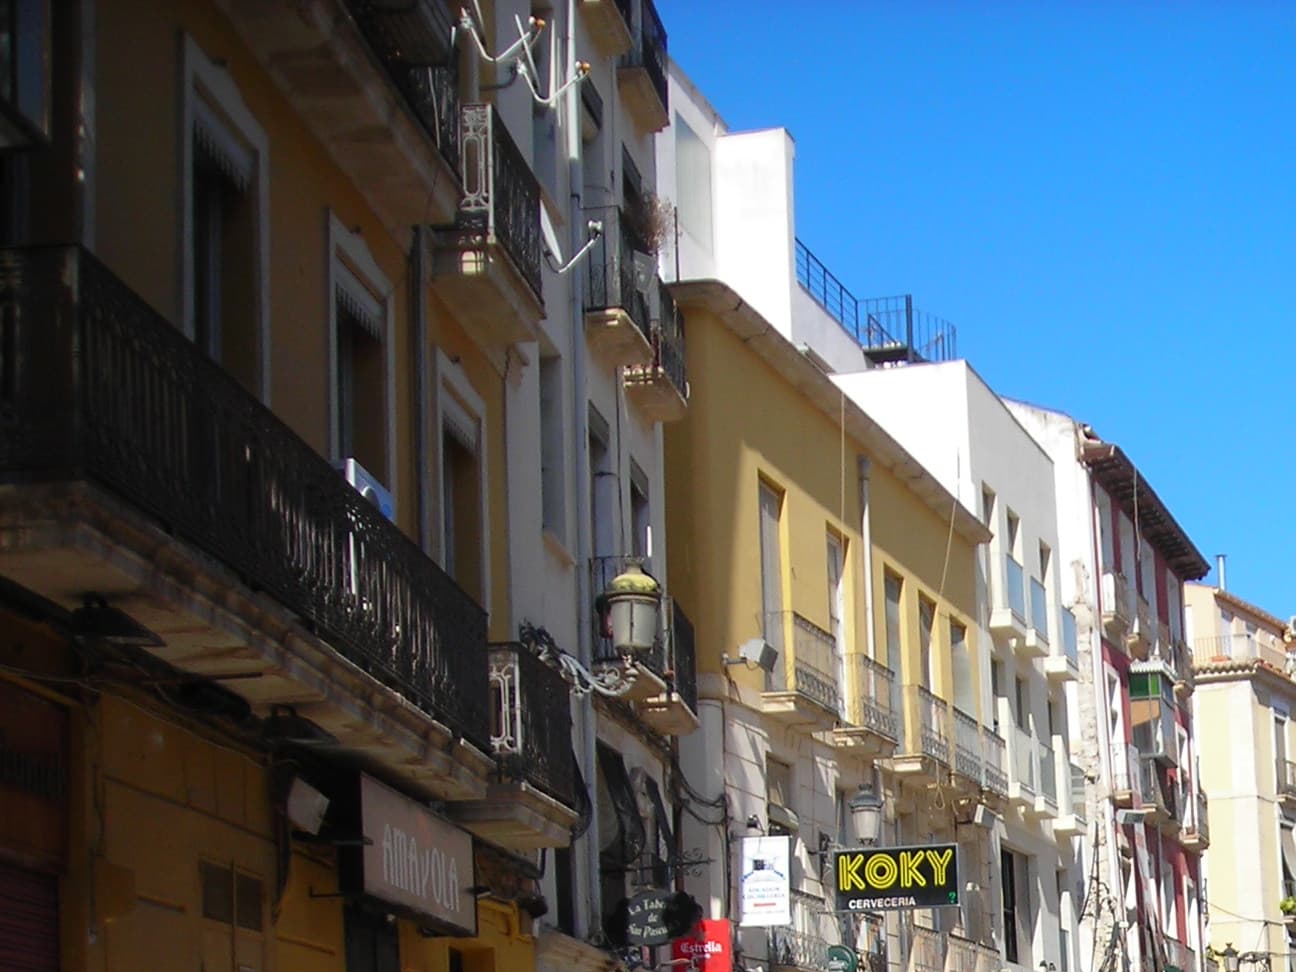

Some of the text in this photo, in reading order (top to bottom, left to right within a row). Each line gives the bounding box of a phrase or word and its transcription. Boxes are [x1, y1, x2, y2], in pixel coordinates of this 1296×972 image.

[839, 849, 953, 892] KOKY
[848, 896, 917, 910] CERVECERIA
[680, 941, 722, 953] Estrella
